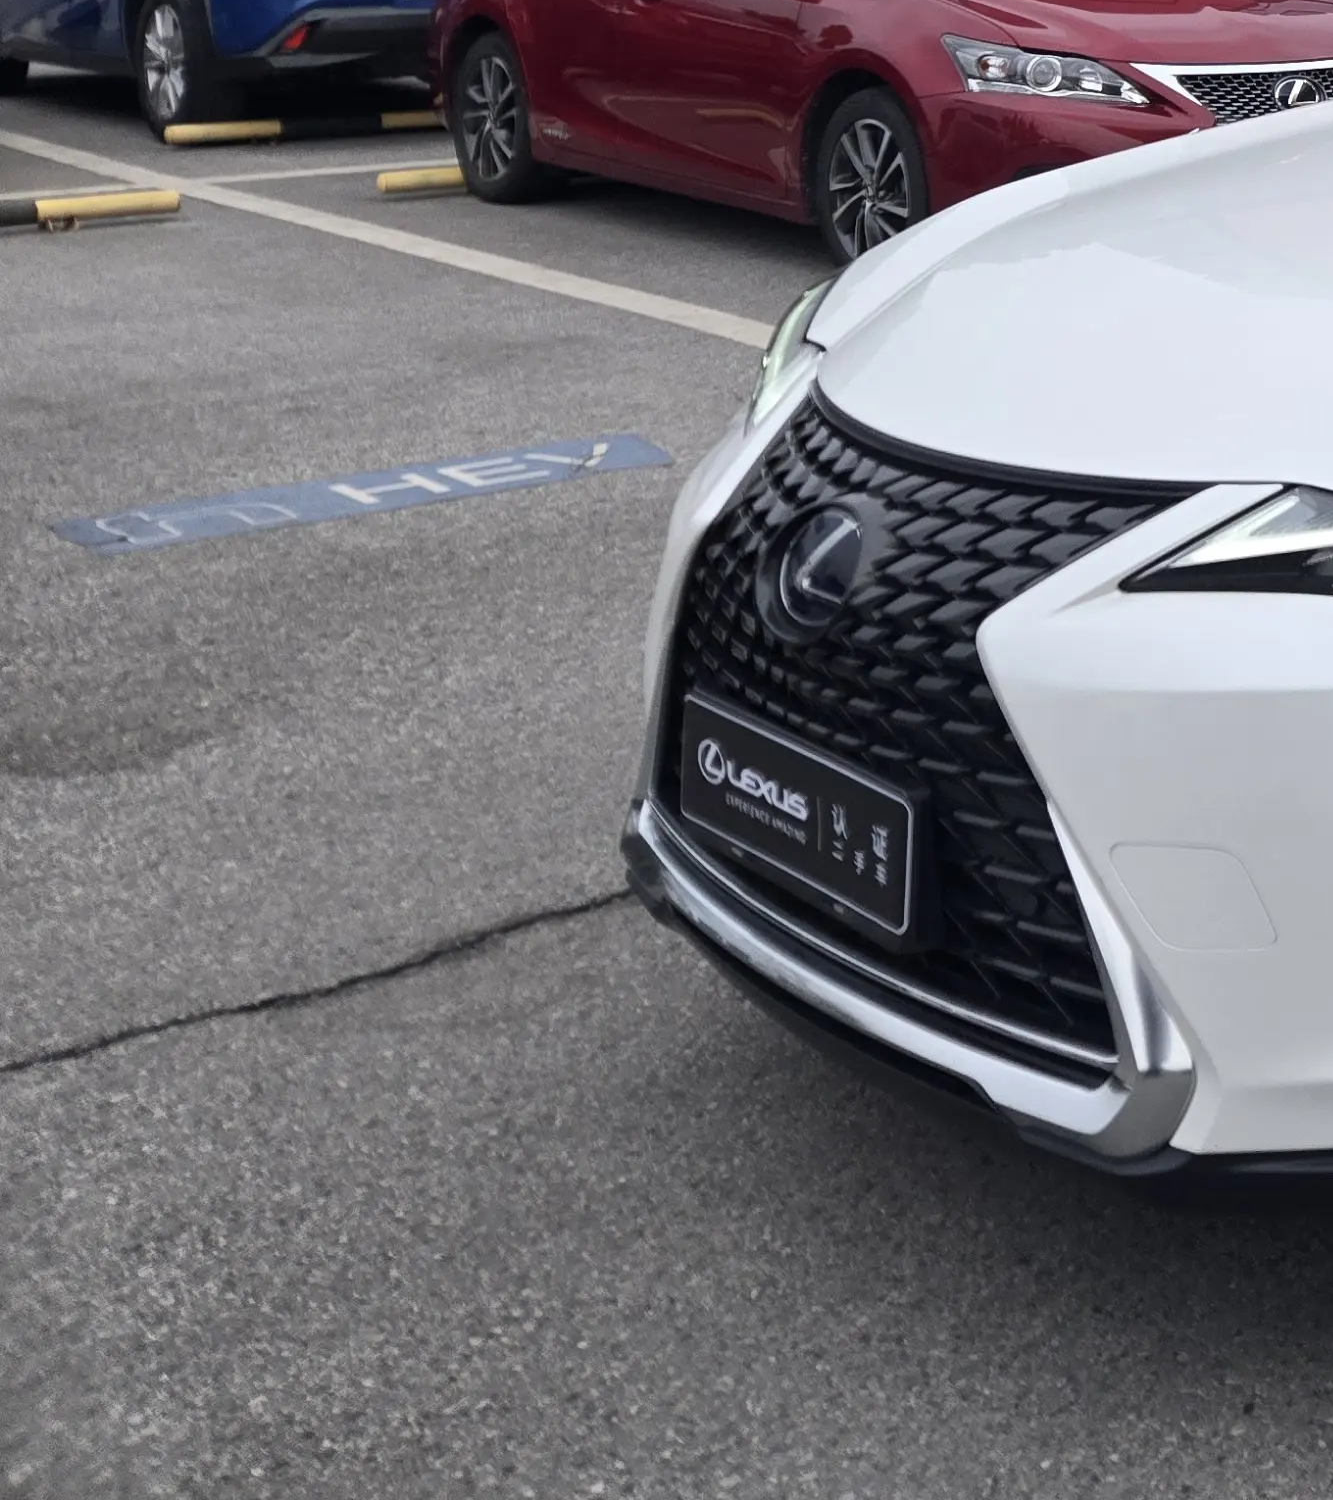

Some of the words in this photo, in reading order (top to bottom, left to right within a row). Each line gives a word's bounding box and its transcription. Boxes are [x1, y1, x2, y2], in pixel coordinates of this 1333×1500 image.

[328, 441, 610, 504] HEV
[724, 792, 771, 826] EXPERIENCE
[726, 758, 810, 822] LEXUS
